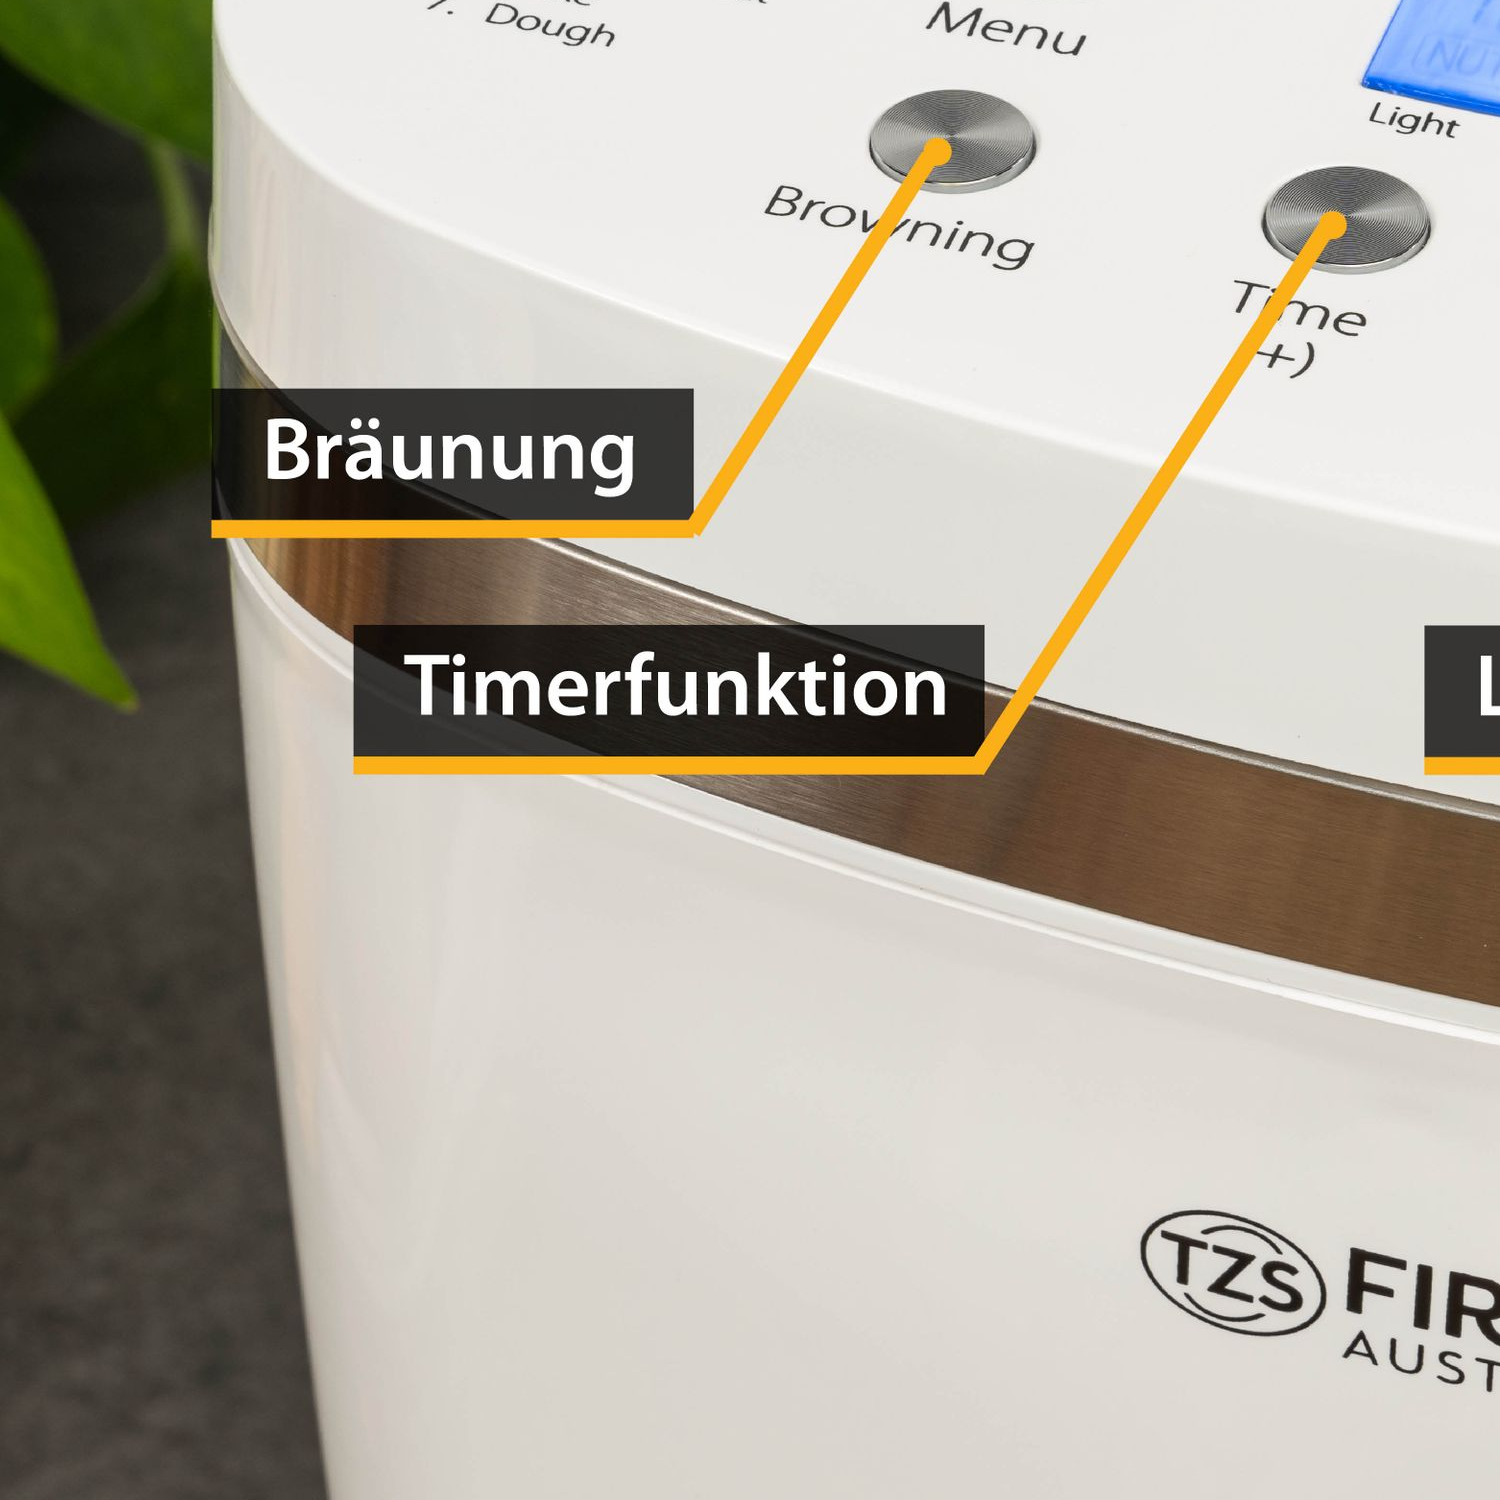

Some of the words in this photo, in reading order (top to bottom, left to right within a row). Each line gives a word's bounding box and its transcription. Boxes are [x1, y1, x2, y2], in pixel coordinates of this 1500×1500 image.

[485, 3, 615, 47] Dough
[926, 2, 1086, 56] Menu
[1369, 102, 1460, 138] Light
[764, 185, 1035, 270] Browning
[1234, 280, 1366, 336] Tme
[1160, 1230, 1304, 1314] TZS
